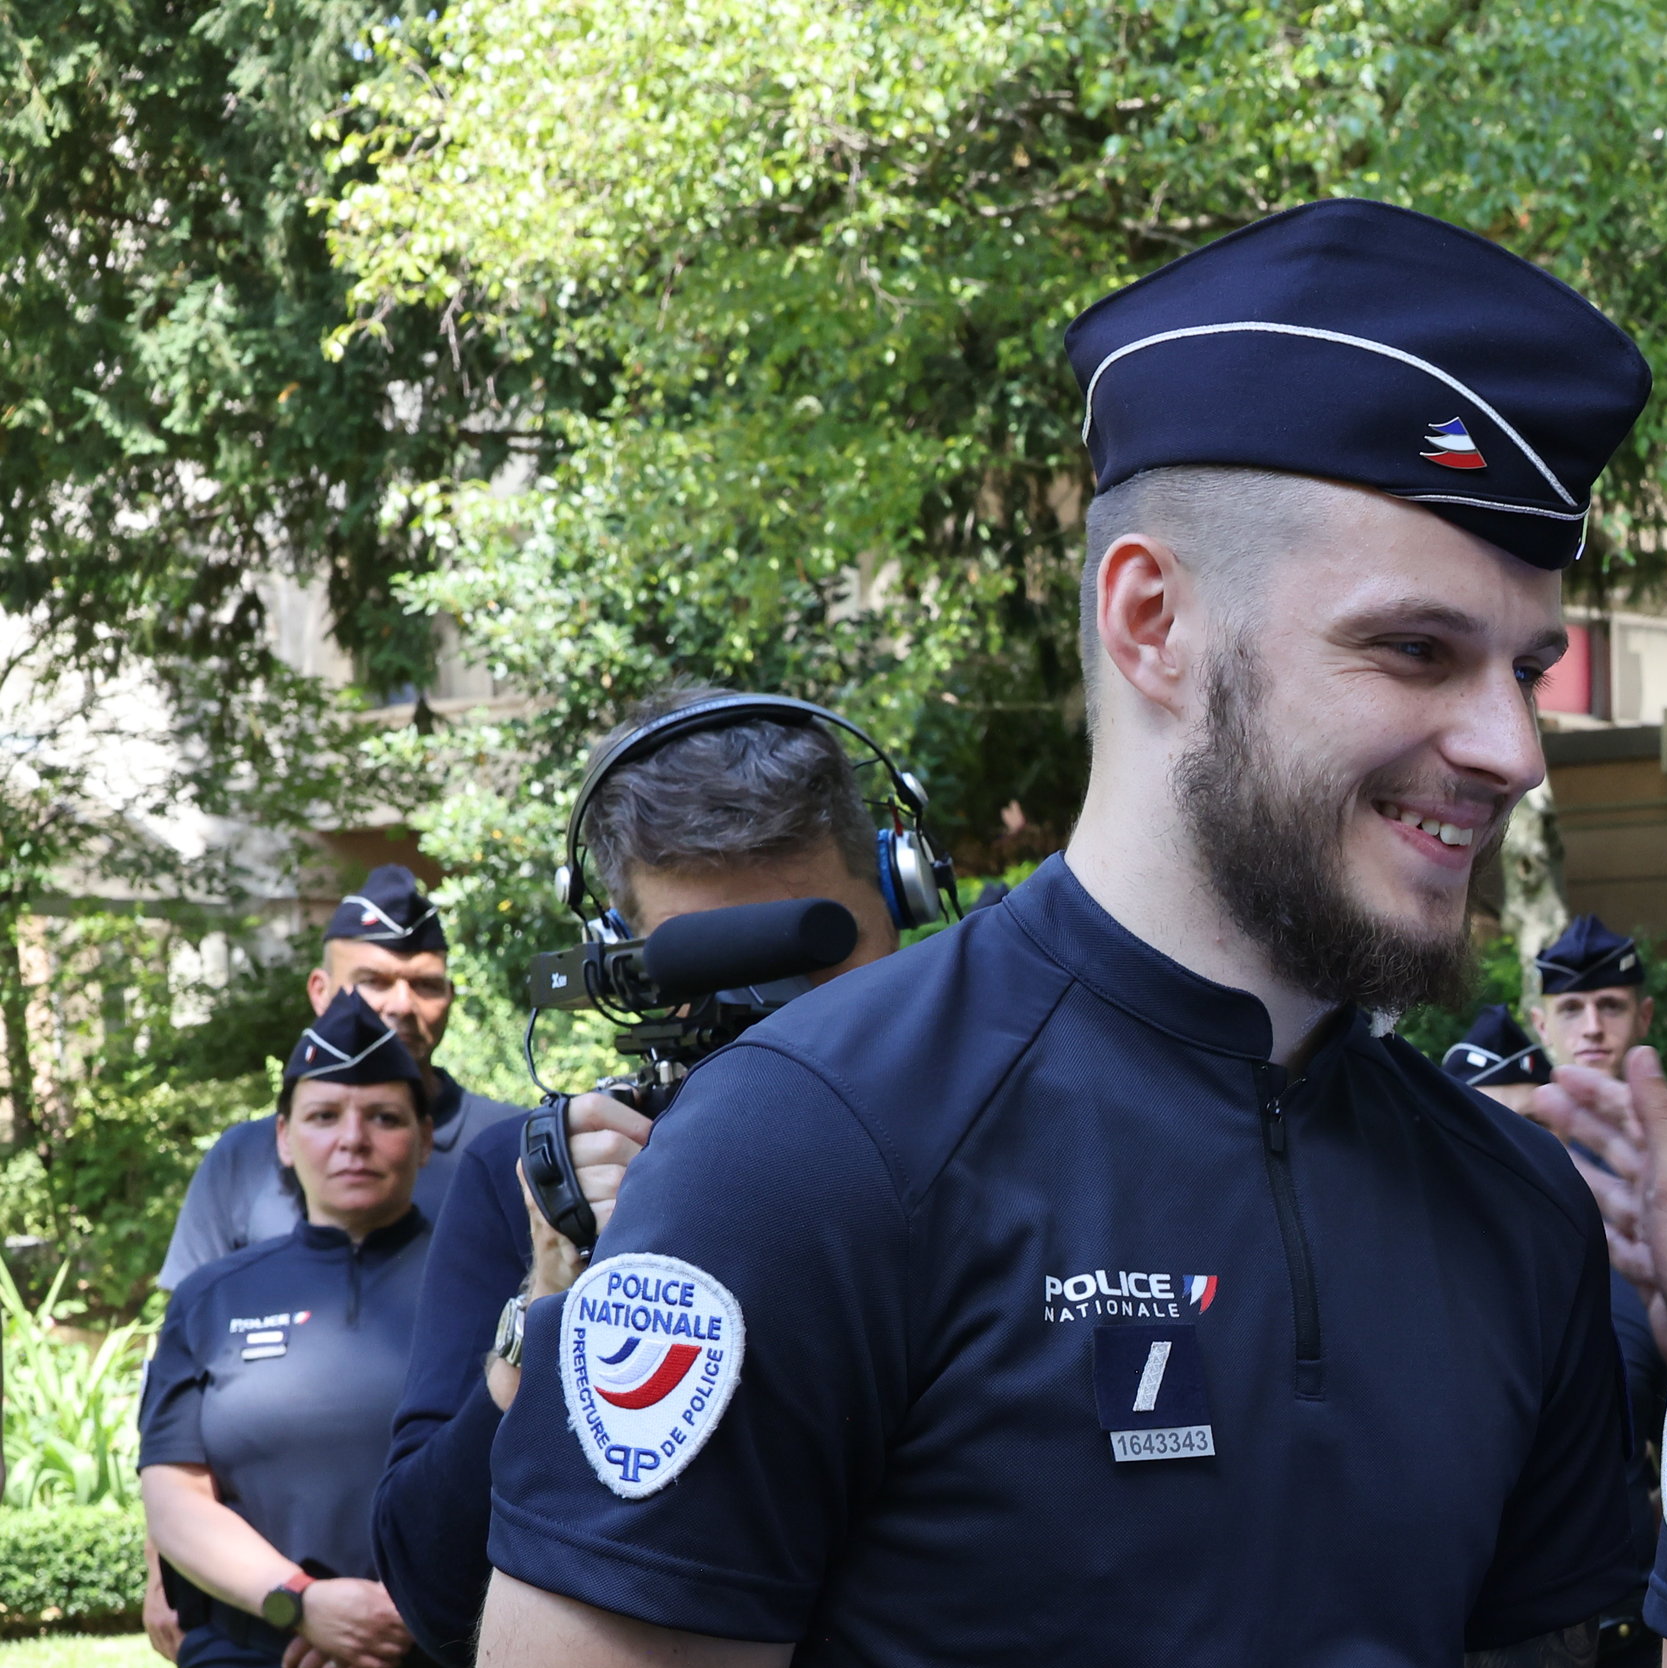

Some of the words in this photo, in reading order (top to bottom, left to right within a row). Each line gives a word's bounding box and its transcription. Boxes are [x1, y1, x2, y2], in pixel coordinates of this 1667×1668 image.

[607, 1271, 695, 1307] POLICE
[1045, 1270, 1175, 1302] POLICE
[579, 1297, 722, 1341] NATIONALE
[1044, 1300, 1180, 1322] NATIONALE
[573, 1328, 610, 1449] PREFECTURE
[660, 1427, 688, 1458] DE
[682, 1348, 724, 1426] POLICE
[1117, 1430, 1209, 1456] 1643343
